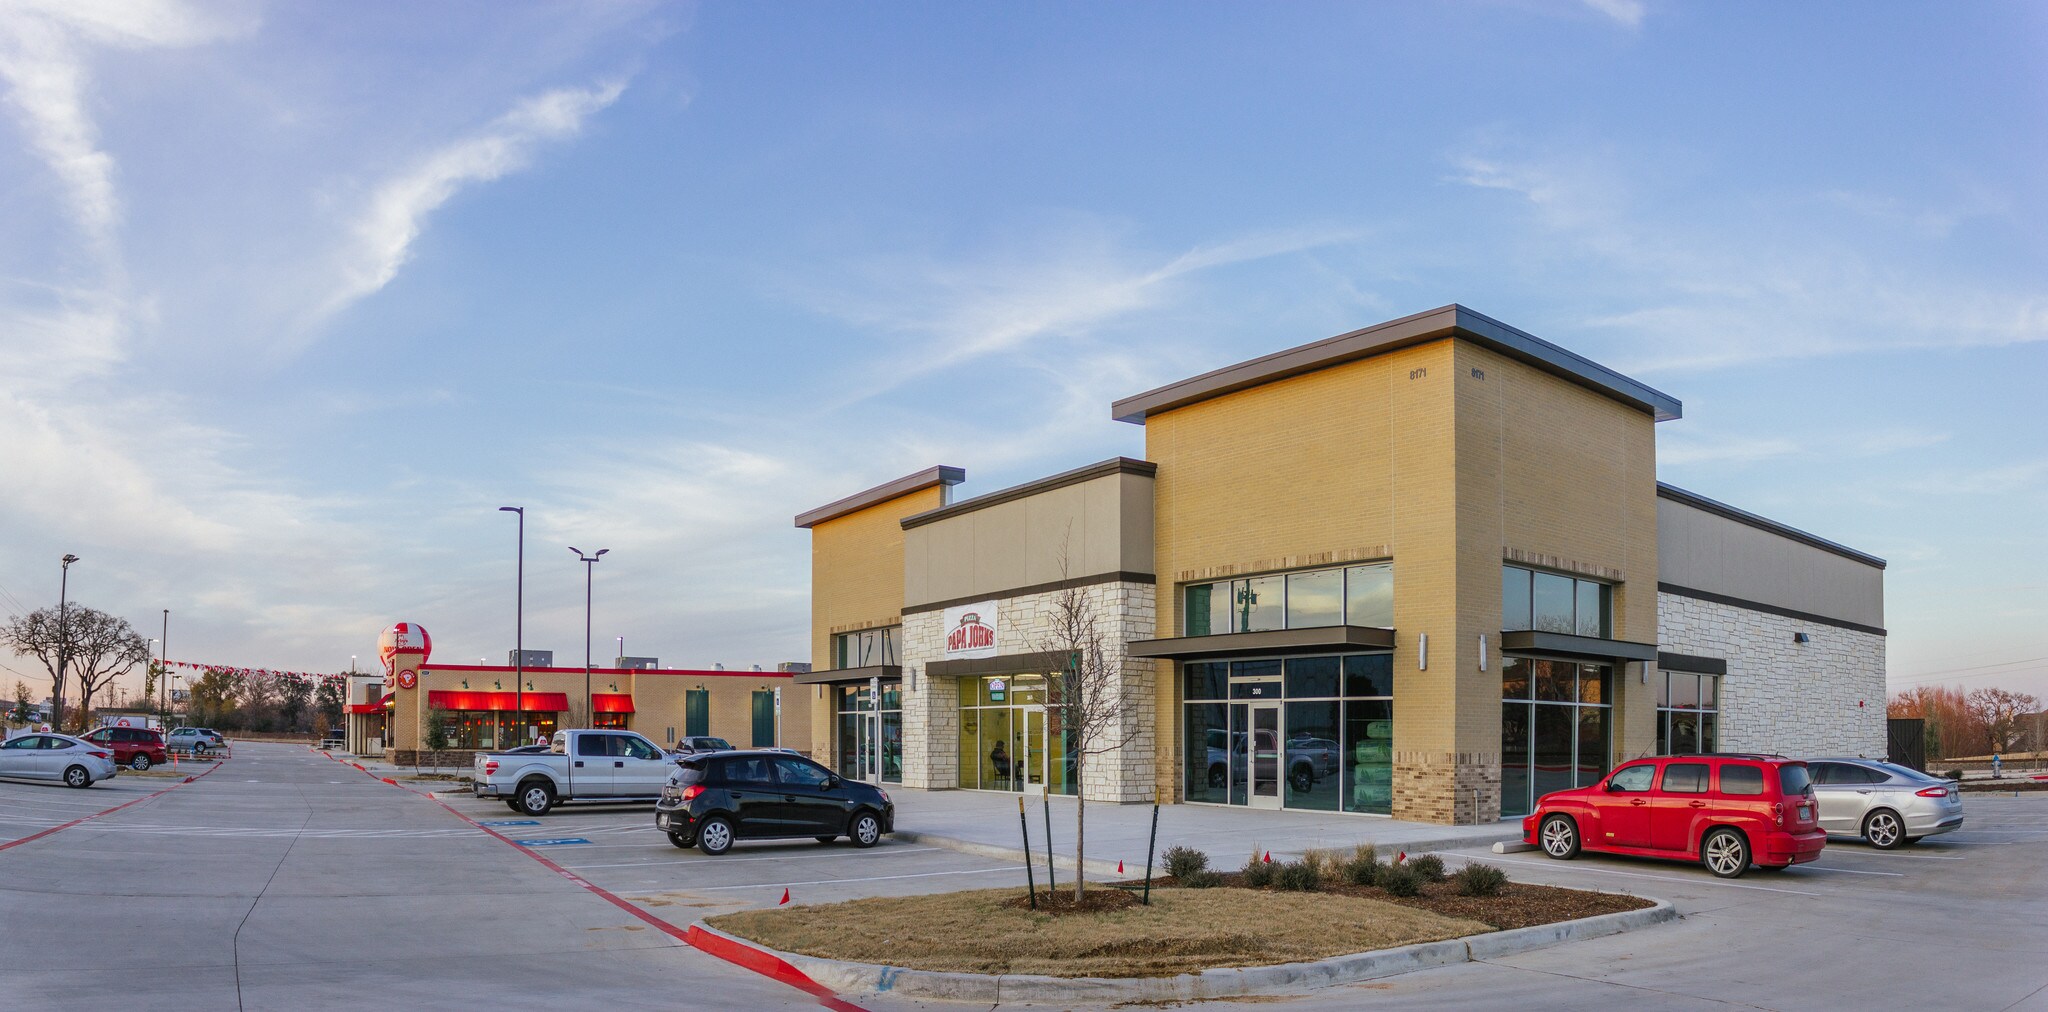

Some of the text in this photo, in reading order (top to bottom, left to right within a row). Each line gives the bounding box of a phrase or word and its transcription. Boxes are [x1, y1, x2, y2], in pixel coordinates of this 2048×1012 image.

[1409, 367, 1427, 380] 8171
[1471, 367, 1485, 381] 8171
[947, 625, 994, 651] PAPA JOHNS
